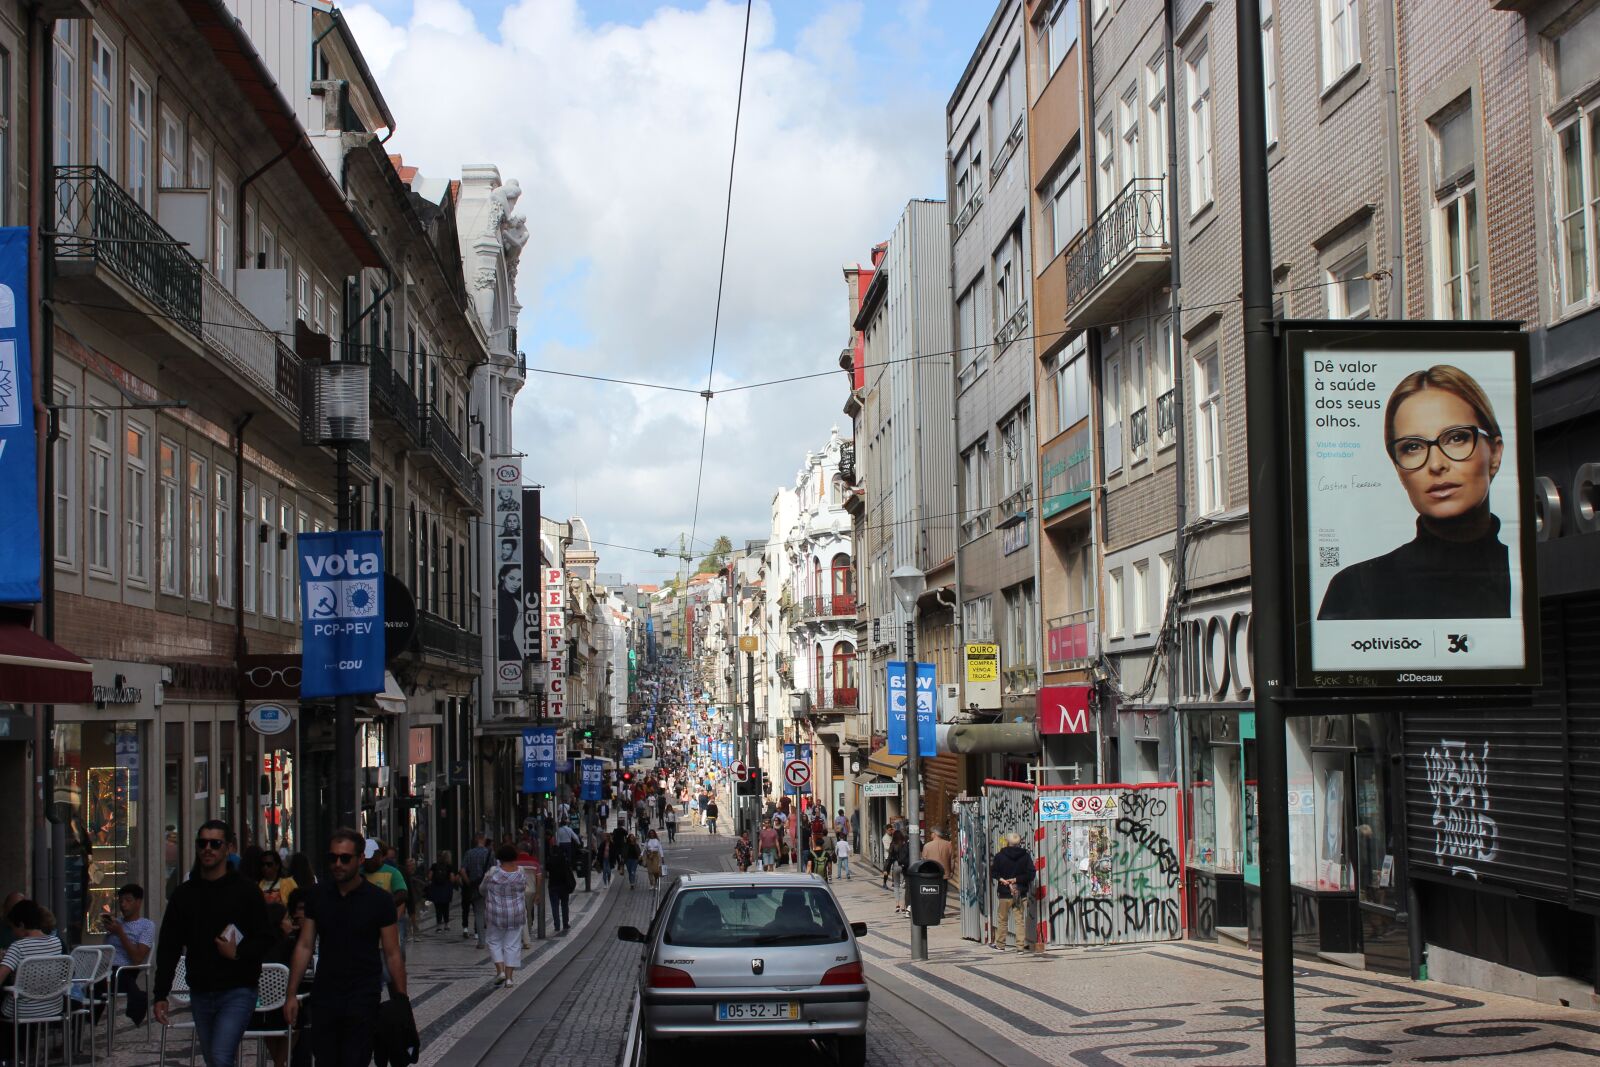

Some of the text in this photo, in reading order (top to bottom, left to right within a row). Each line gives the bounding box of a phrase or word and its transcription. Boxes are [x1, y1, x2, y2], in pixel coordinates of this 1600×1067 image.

[1314, 360, 1377, 373] Dê valor
[1315, 378, 1376, 391] à saúde
[1315, 396, 1381, 409] dos seus
[1316, 415, 1360, 428] olhos.
[1316, 441, 1337, 449] Visite
[304, 549, 379, 577] vota
[314, 622, 372, 636] PCP-PEV
[524, 592, 539, 656] fnac
[549, 570, 563, 716] PERFECT
[1351, 637, 1422, 653] optivisão
[339, 660, 363, 670] CDU
[1397, 674, 1443, 682] JCDecaux
[1057, 704, 1088, 733] M
[525, 733, 554, 744] vota
